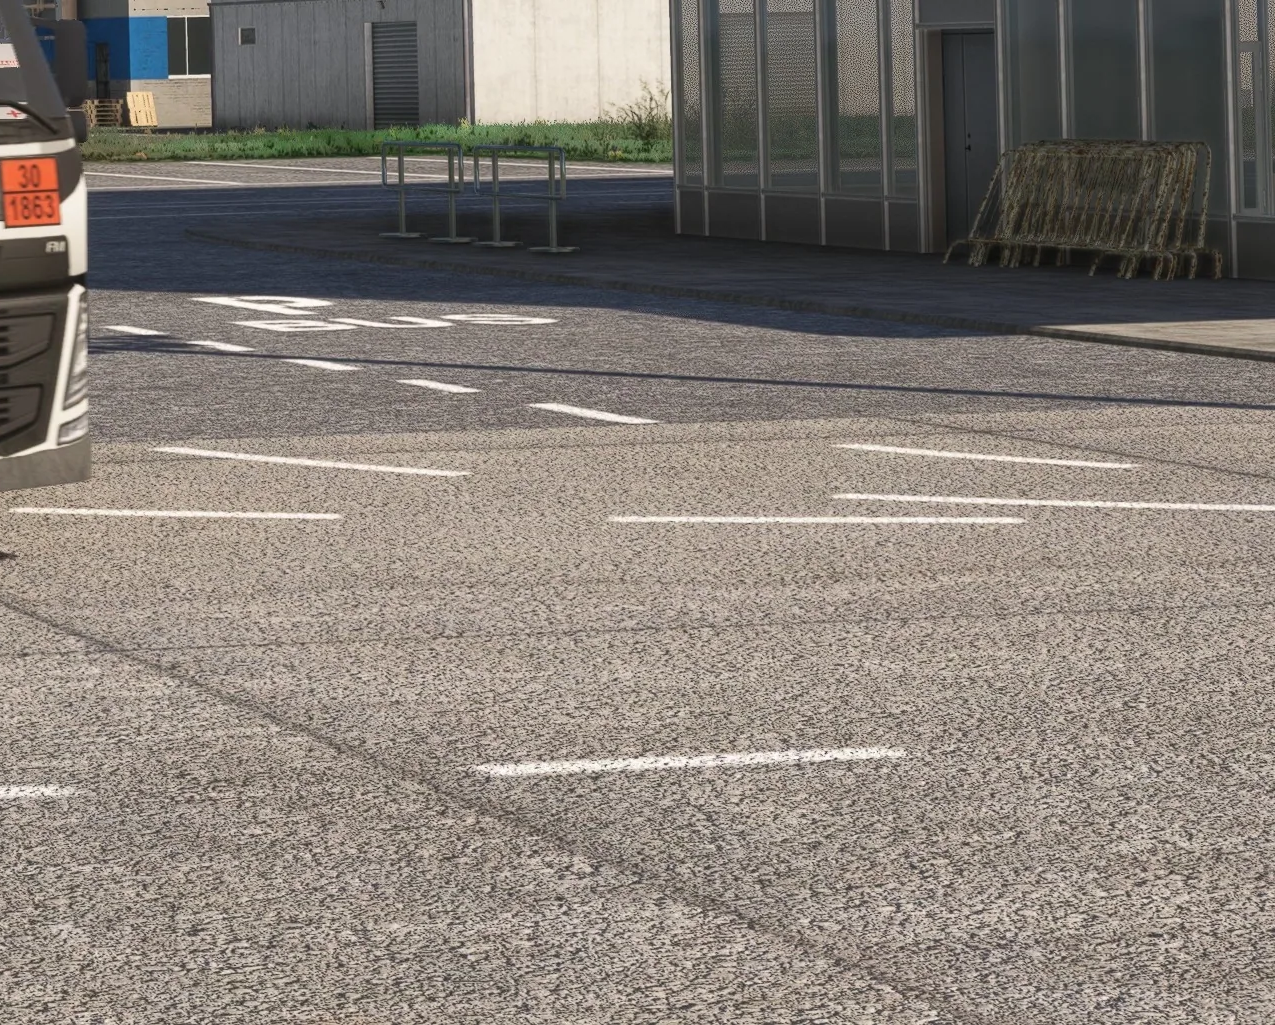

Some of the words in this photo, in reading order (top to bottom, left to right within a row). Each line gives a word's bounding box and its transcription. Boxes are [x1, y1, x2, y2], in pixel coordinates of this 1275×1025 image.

[17, 164, 42, 189] 30
[9, 195, 56, 222] 1863
[191, 295, 334, 315] P
[228, 313, 561, 332] BUS
